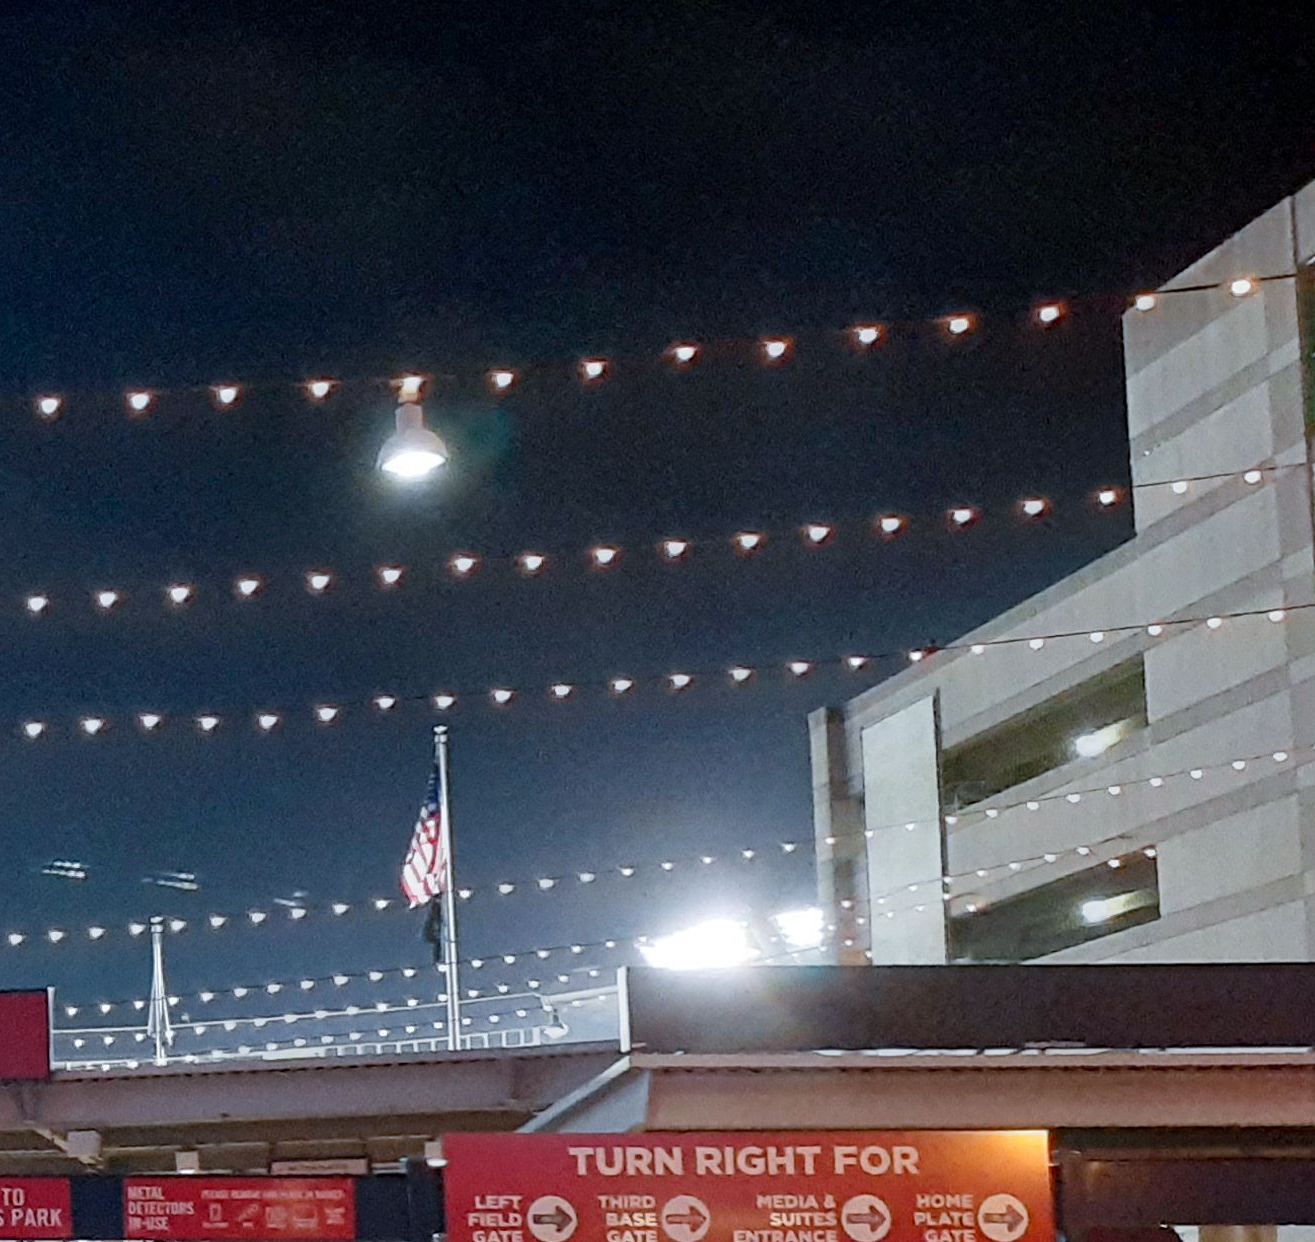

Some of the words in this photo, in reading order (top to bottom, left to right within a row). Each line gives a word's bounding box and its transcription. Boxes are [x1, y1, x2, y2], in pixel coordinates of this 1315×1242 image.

[568, 1146, 683, 1176] TURN
[696, 1146, 821, 1176] RIGHT
[834, 1145, 920, 1175] FOR
[4, 1187, 26, 1206] TO
[127, 1186, 164, 1201] METAL
[127, 1201, 195, 1216] DETECTORS
[474, 1195, 522, 1210] LEFT
[597, 1195, 656, 1210] THIRD
[756, 1194, 821, 1210] MEDIA
[823, 1194, 837, 1210] &
[916, 1194, 974, 1210] HOME
[11, 1208, 63, 1227] PARK
[468, 1212, 523, 1228] FIELD
[605, 1212, 658, 1228] BASE
[769, 1212, 838, 1227] SUITES
[913, 1211, 975, 1227] PLATE
